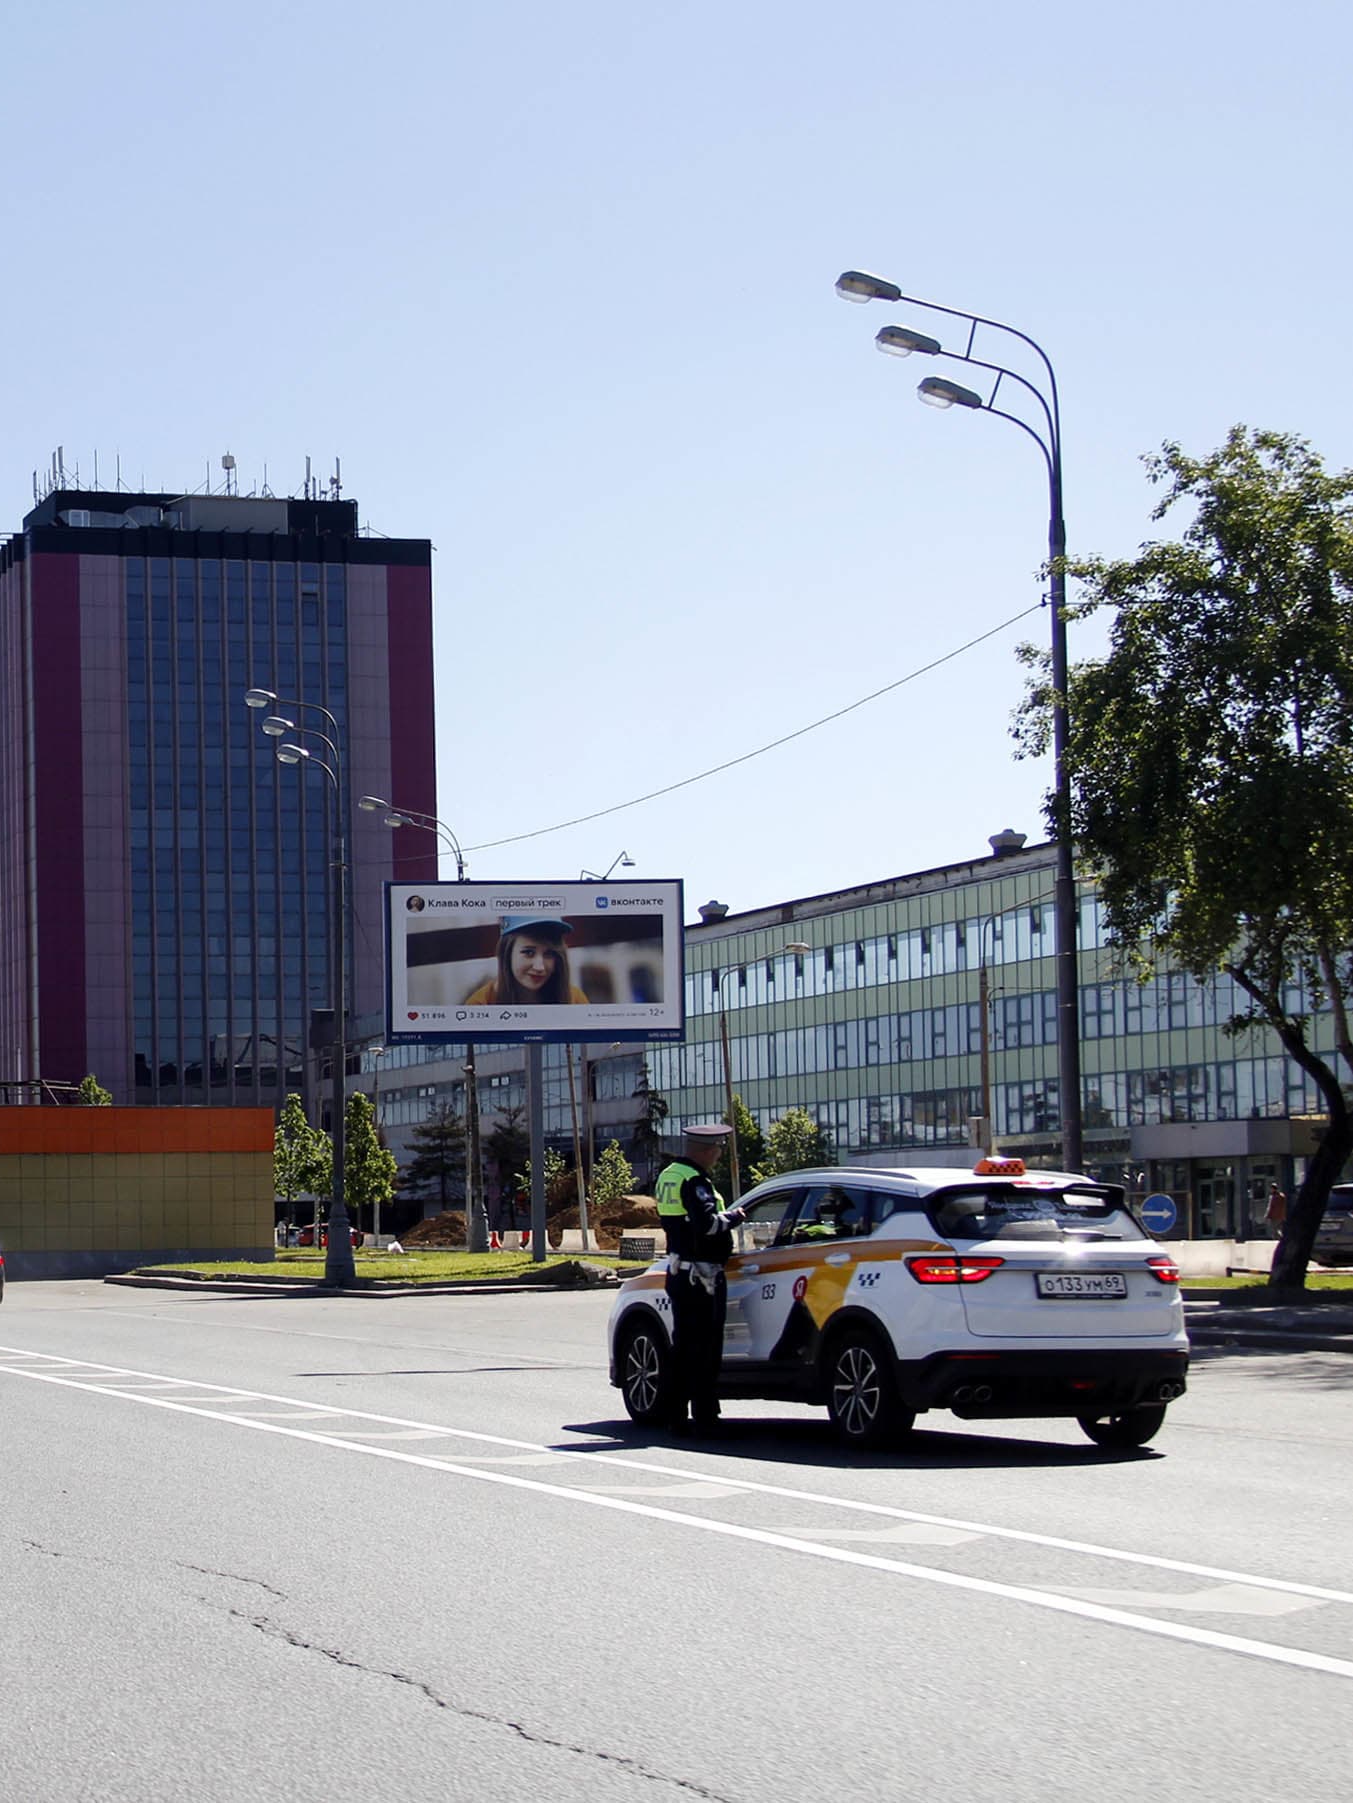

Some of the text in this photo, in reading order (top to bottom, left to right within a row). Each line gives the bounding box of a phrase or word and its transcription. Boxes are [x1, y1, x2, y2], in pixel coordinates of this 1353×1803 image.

[428, 898, 486, 908] Клава Кока
[495, 896, 561, 909] первый трек
[610, 897, 664, 906] вконтакте
[762, 1284, 776, 1300] 133
